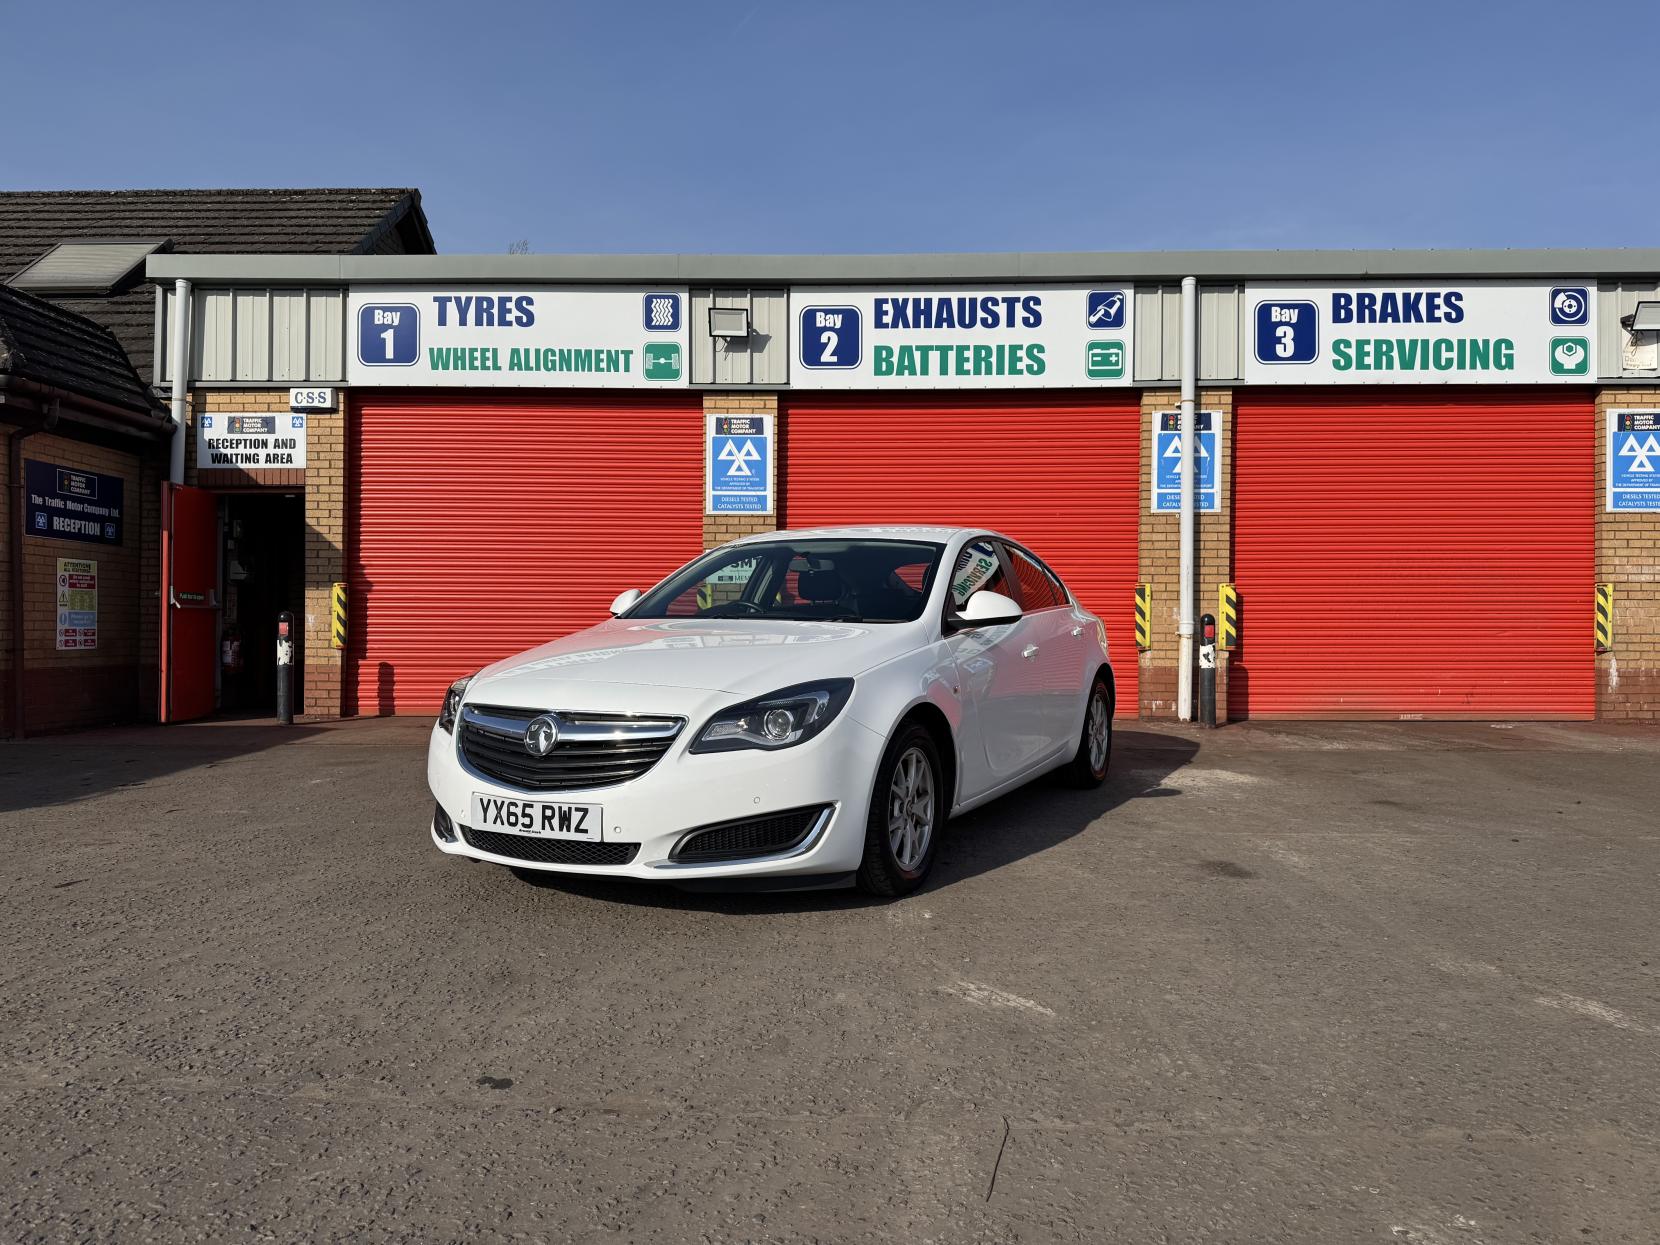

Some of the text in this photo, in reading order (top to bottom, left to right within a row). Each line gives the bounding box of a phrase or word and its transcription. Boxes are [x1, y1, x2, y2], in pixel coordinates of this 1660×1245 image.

[374, 309, 401, 326] Bay
[432, 295, 535, 328] TYRES
[815, 311, 843, 328] Bay
[873, 295, 1043, 329] EXHAUSTS
[1271, 306, 1299, 324] Bay
[1331, 291, 1465, 324] BRAKES
[380, 328, 394, 359] 1
[820, 331, 839, 363] 2
[1275, 325, 1295, 358] 3
[1331, 337, 1515, 371] SERVICING
[428, 347, 634, 373] WHEEL ALIGNMENT
[873, 343, 1046, 377] BATTERIES
[207, 438, 296, 450] RECEPTION AND
[210, 453, 293, 464] WAITING AREA
[70, 480, 86, 488] MOTOR
[70, 486, 91, 495] COMPANY
[31, 494, 43, 505] The
[45, 496, 65, 508] Traffic
[66, 500, 83, 511] Motor
[83, 503, 109, 517] Company
[52, 516, 101, 536] RECEPTION
[479, 797, 589, 834] YX65 RWZ
